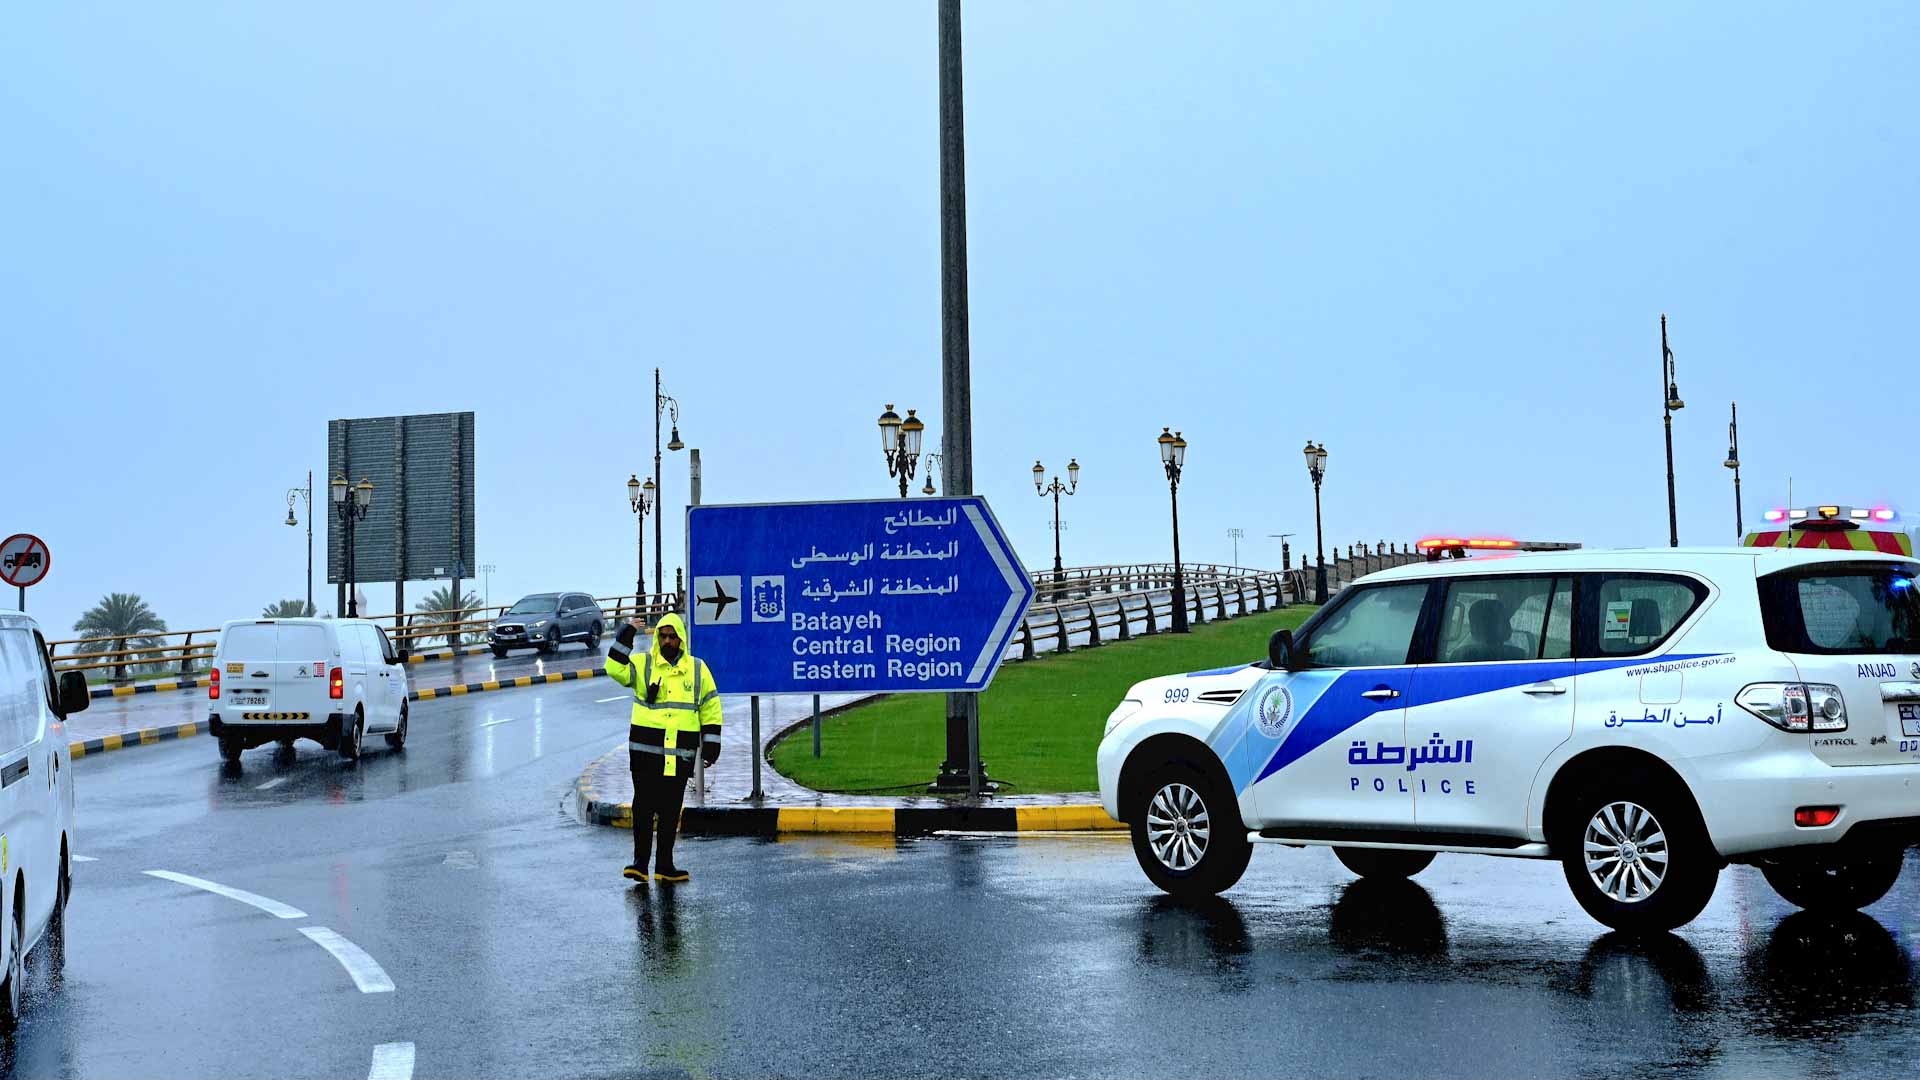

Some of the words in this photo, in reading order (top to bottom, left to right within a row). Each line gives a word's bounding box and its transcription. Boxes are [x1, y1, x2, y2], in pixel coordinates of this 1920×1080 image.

[884, 506, 957, 535] البطائح
[791, 542, 873, 568] الوسطى
[880, 540, 958, 561] المنطقة
[801, 577, 873, 603] الشرقية
[880, 575, 958, 596] المنطقة
[760, 602, 778, 614] 88
[791, 611, 882, 633] Batayeh
[792, 635, 873, 655] Central
[886, 634, 961, 656] Region
[792, 660, 875, 680] Eastern
[887, 659, 962, 682] Region
[1626, 656, 1736, 677] www.shjpolice.gov.ae
[1858, 664, 1896, 678] ANJAD
[1164, 688, 1189, 704] 999
[1604, 706, 1670, 728] الطرق
[1673, 703, 1723, 728] أمن
[1348, 732, 1473, 771] الشرطة
[1814, 738, 1858, 747] PATROL
[1351, 777, 1475, 795] POLICE
